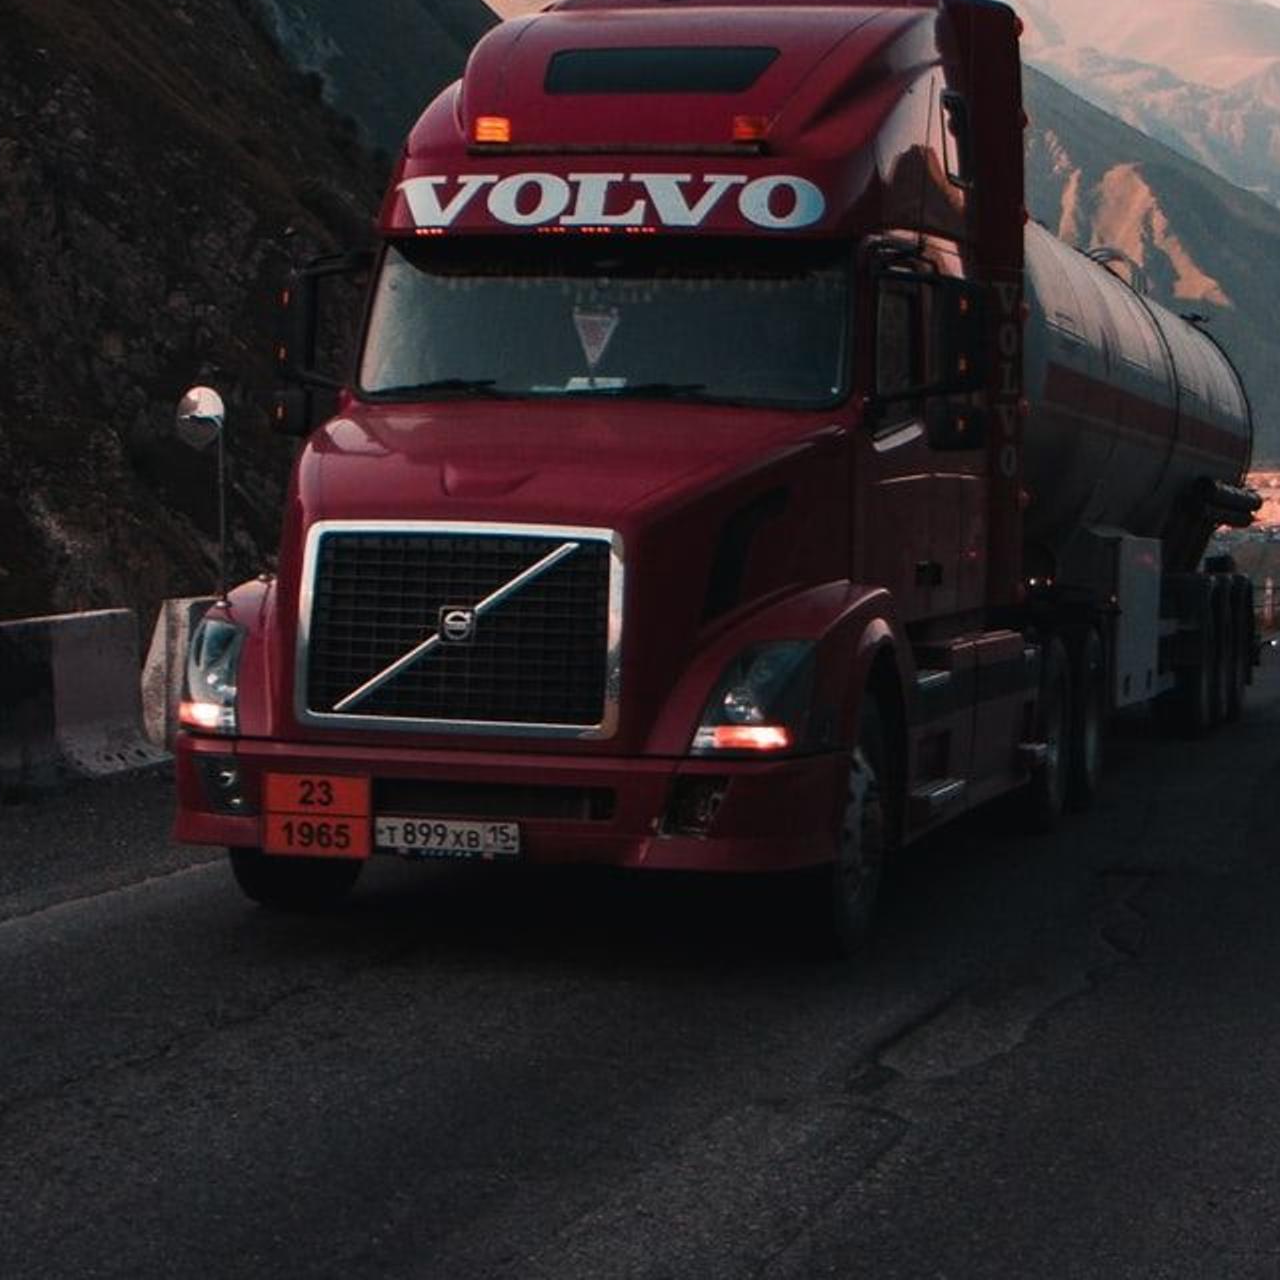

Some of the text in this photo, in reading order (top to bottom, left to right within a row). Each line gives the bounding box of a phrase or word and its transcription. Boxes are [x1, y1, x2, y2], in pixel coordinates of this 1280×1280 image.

[396, 173, 827, 229] VOLVO
[992, 281, 1020, 478] VOLVO
[299, 780, 333, 806] 23
[282, 822, 351, 848] 1965
